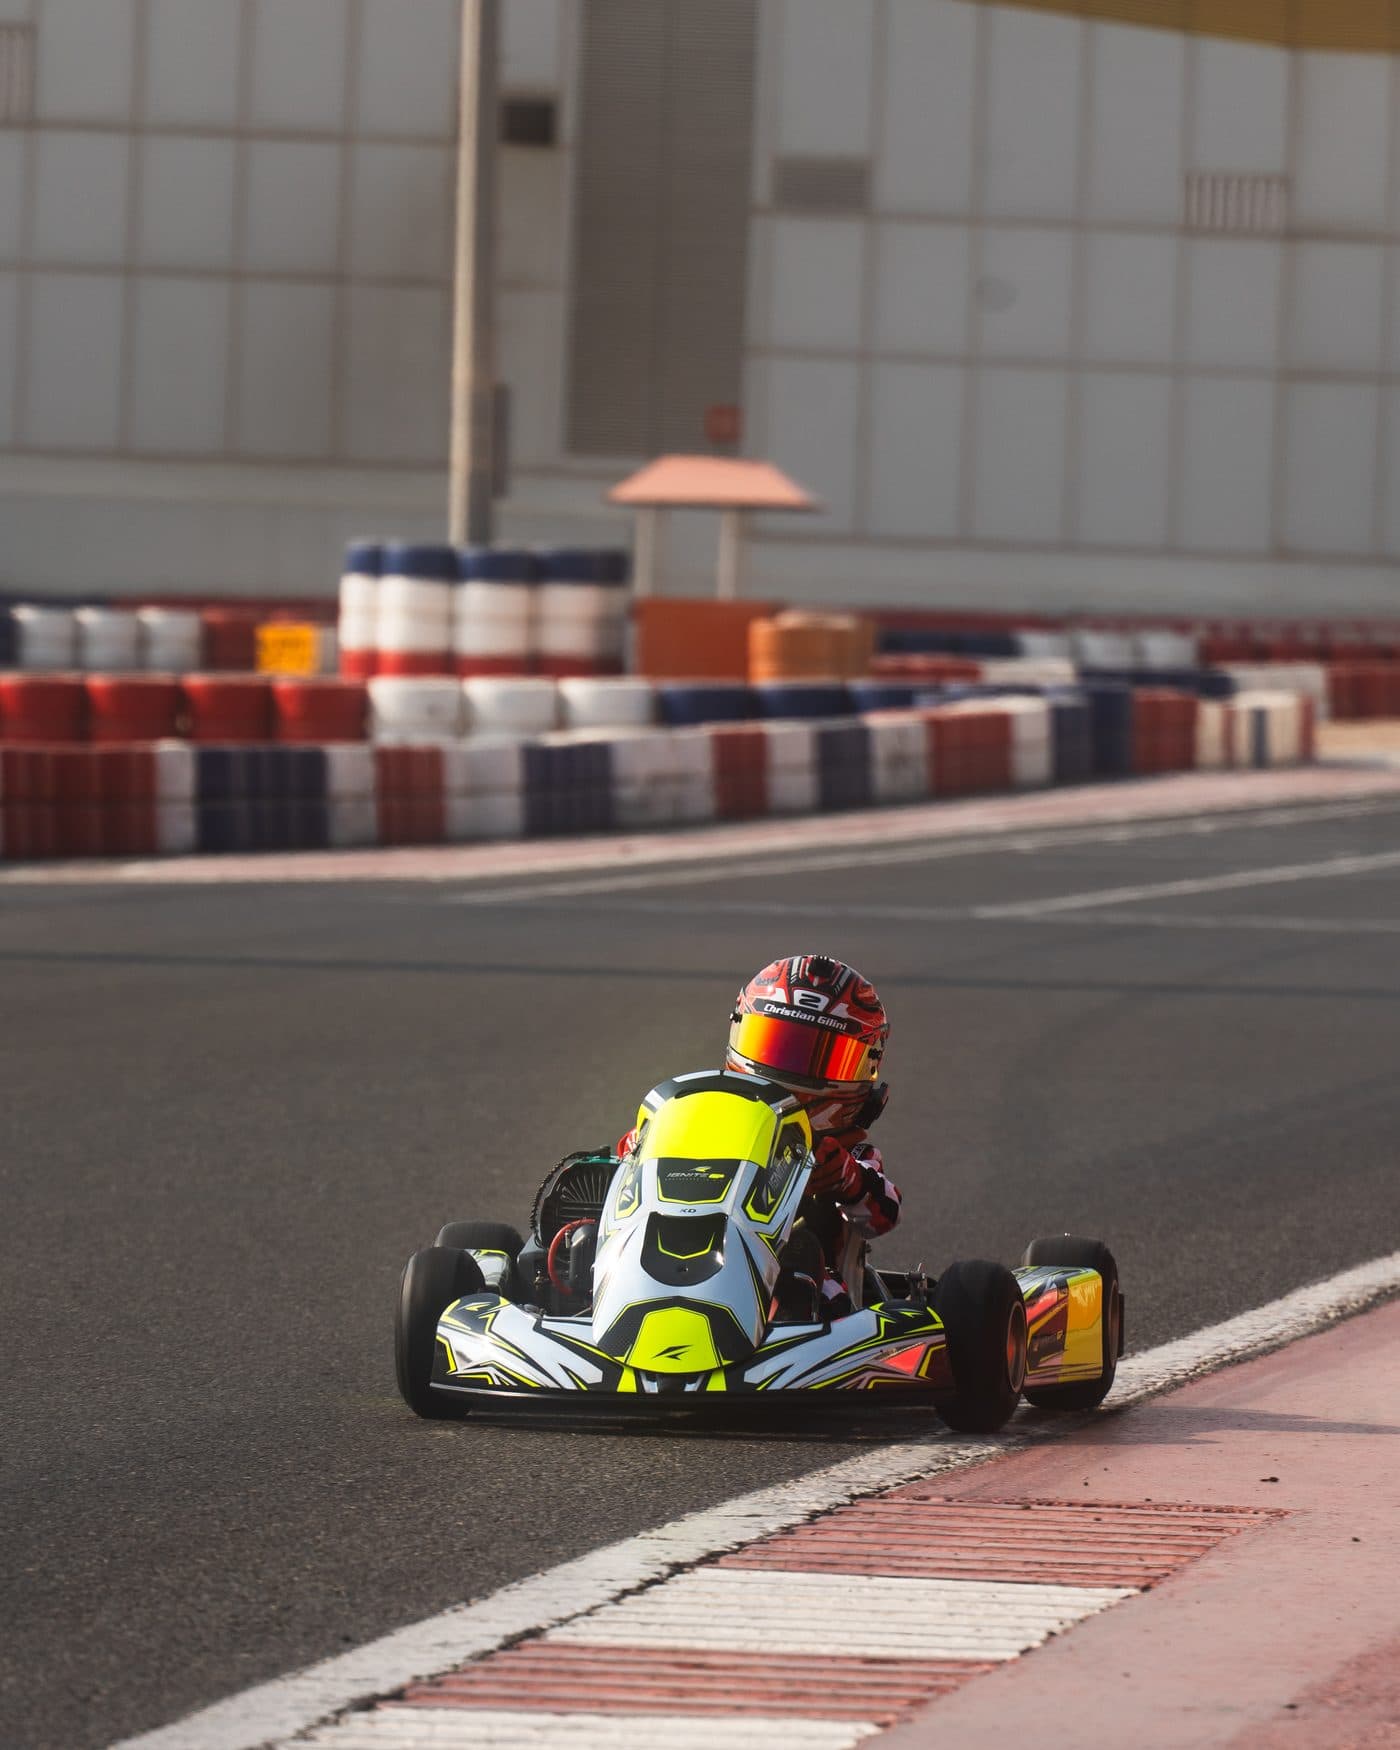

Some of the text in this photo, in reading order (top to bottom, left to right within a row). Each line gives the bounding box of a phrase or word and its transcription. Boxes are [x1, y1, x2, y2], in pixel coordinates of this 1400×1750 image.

[798, 993, 822, 1009] 2
[763, 1003, 848, 1031] Christian Gilini
